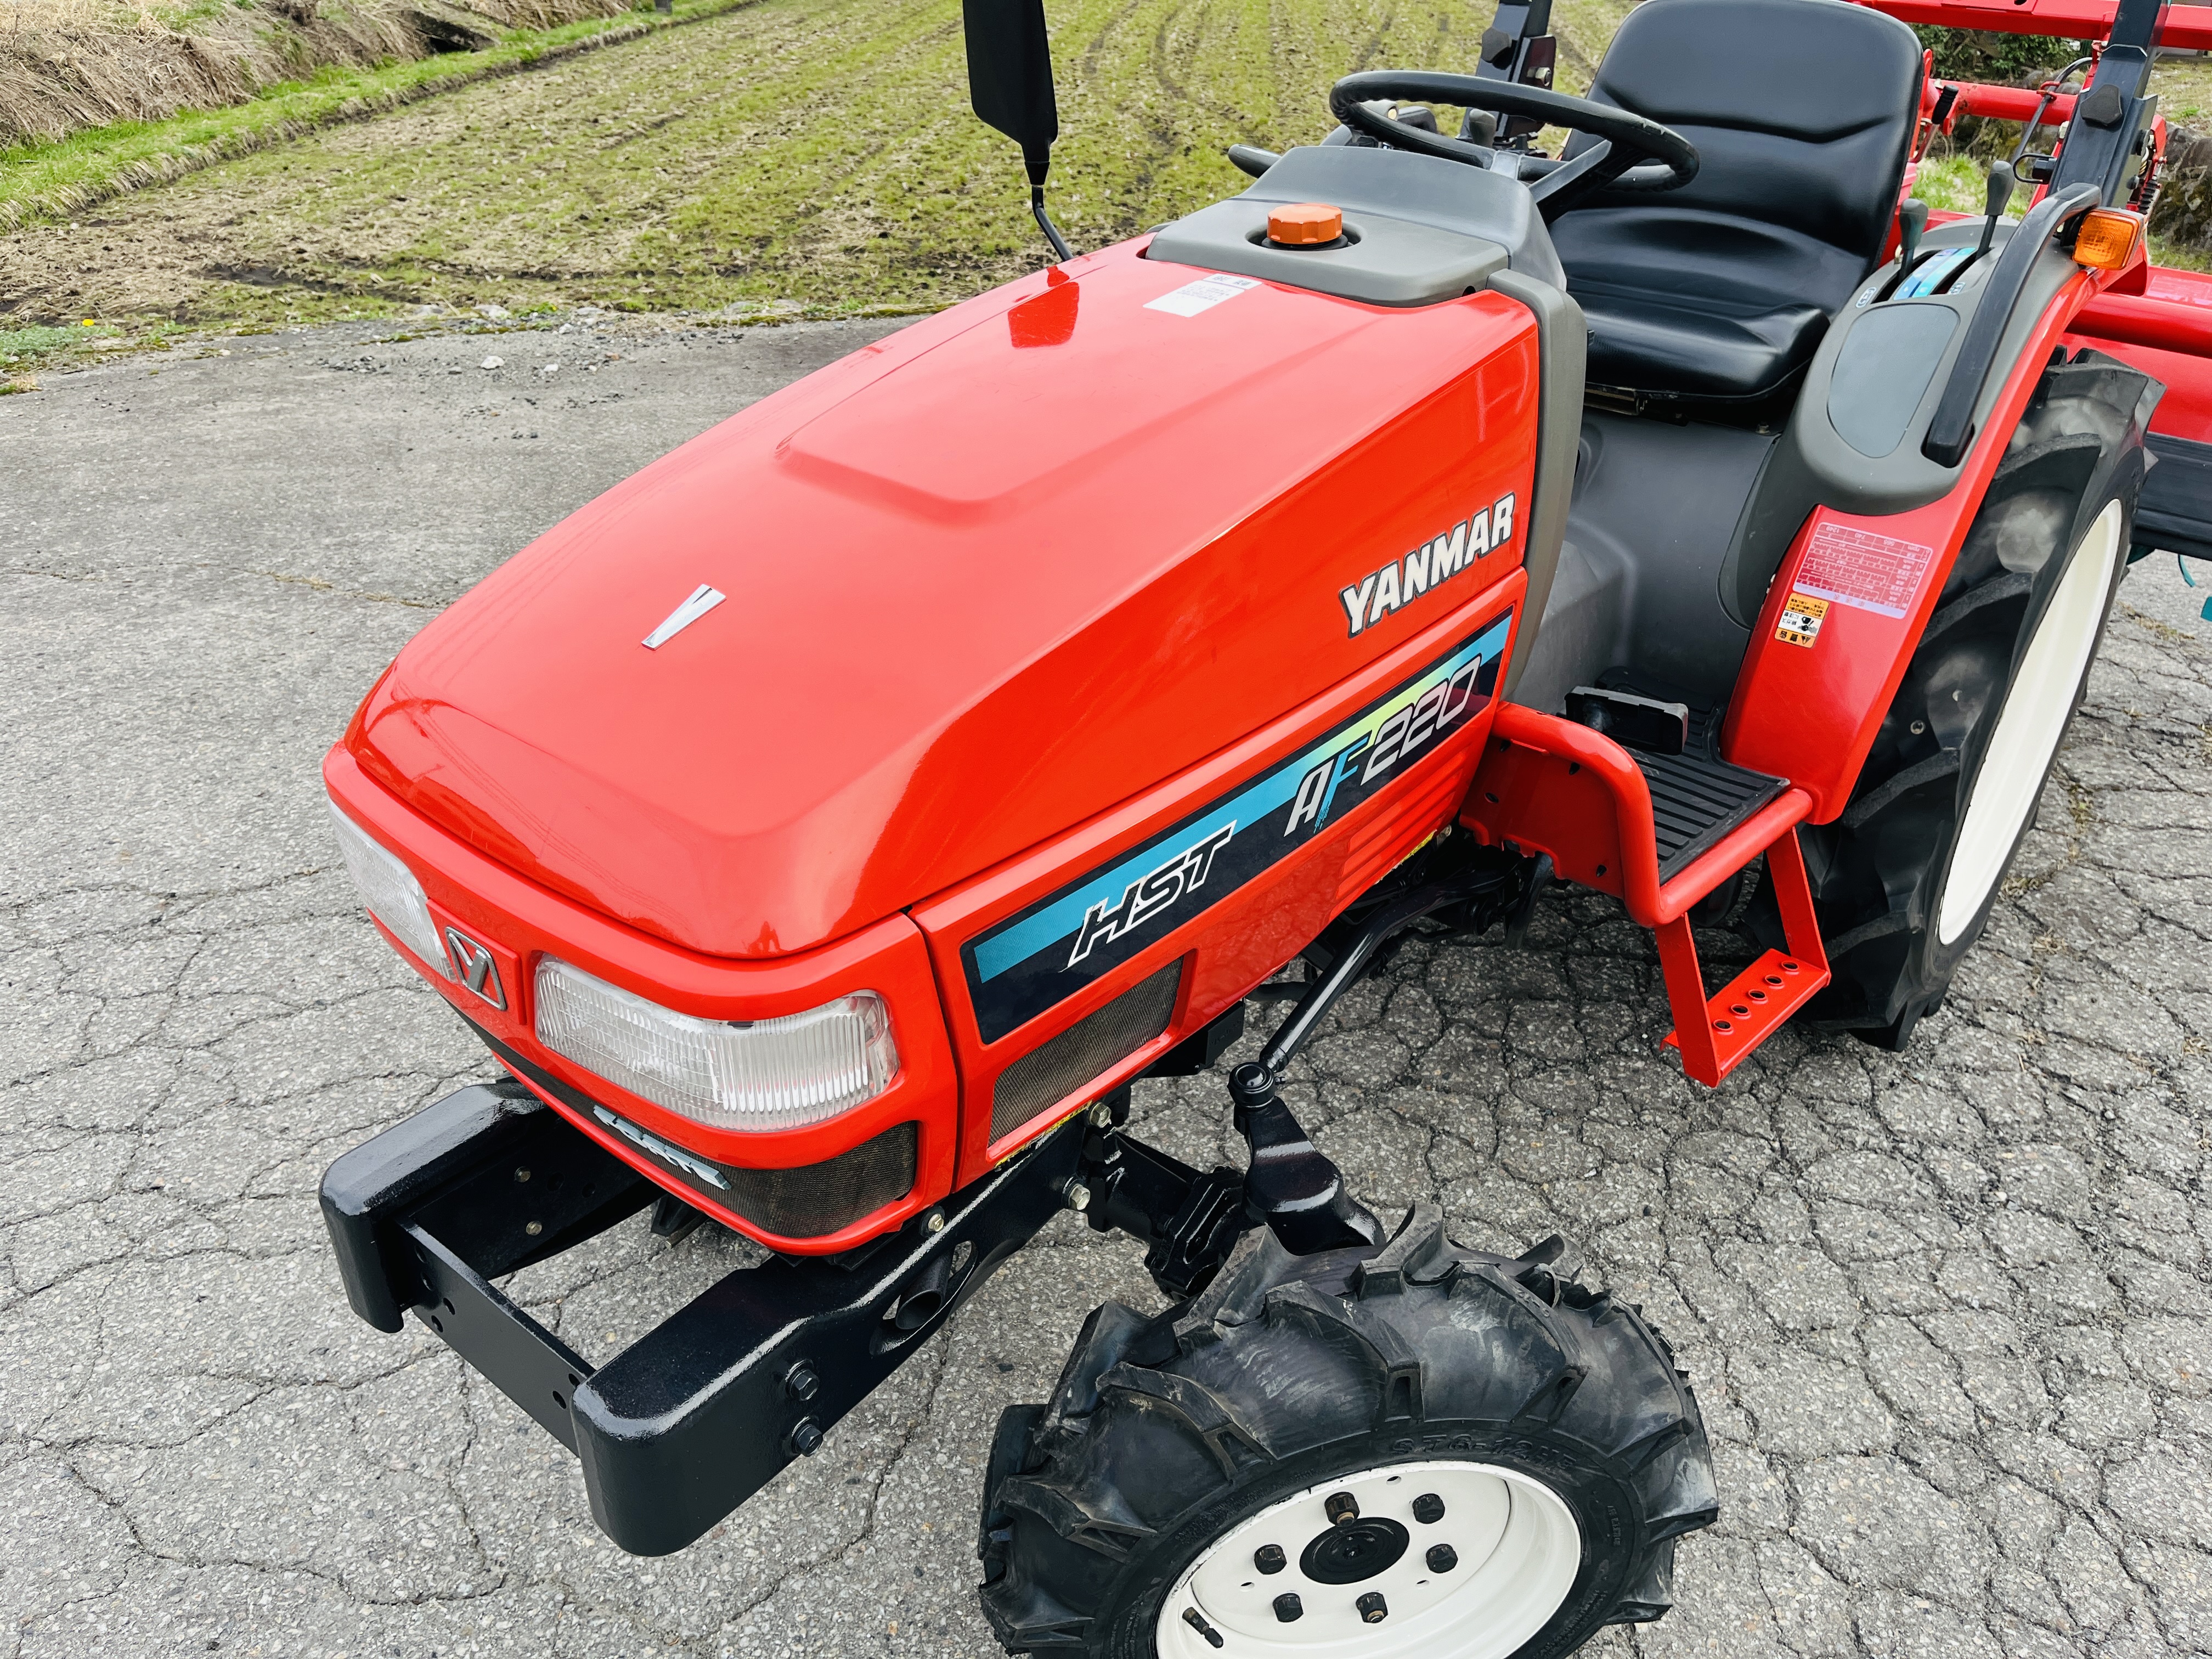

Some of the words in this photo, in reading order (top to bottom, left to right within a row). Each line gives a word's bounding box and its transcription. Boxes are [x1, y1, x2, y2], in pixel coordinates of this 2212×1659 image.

[1339, 492, 1516, 639] YANMAR
[1283, 653, 1482, 837] AF220
[1066, 819, 1238, 968] HST
